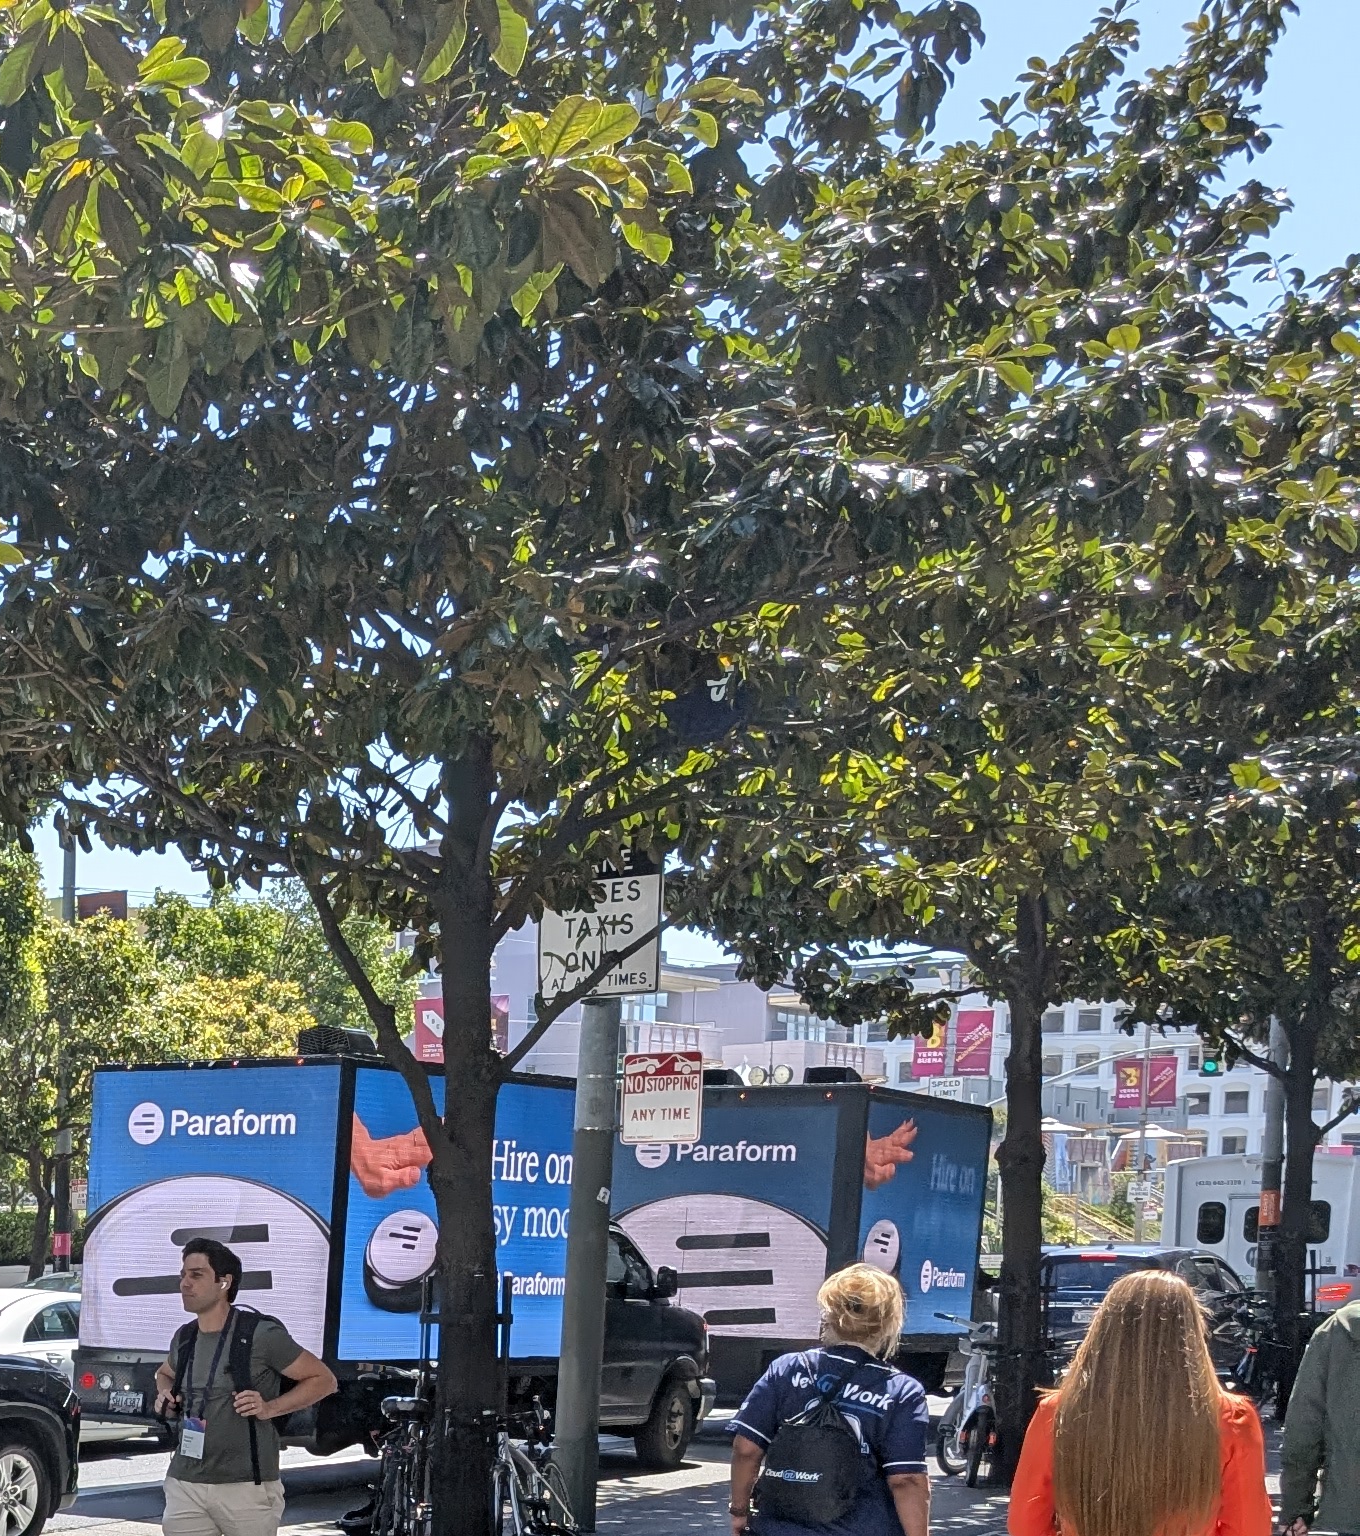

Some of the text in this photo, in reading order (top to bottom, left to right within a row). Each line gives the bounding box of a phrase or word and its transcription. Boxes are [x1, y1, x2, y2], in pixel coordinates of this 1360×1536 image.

[564, 913, 634, 939] TAXIS
[606, 971, 648, 987] TIMES
[625, 1075, 698, 1093] NO STOPPING
[934, 1089, 958, 1097] LIMIT
[170, 1108, 296, 1136] Paraform
[631, 1107, 691, 1121] ANY TIME
[491, 1139, 539, 1183] Hire
[676, 1140, 797, 1162] Paraform
[931, 1266, 966, 1288] Paraform
